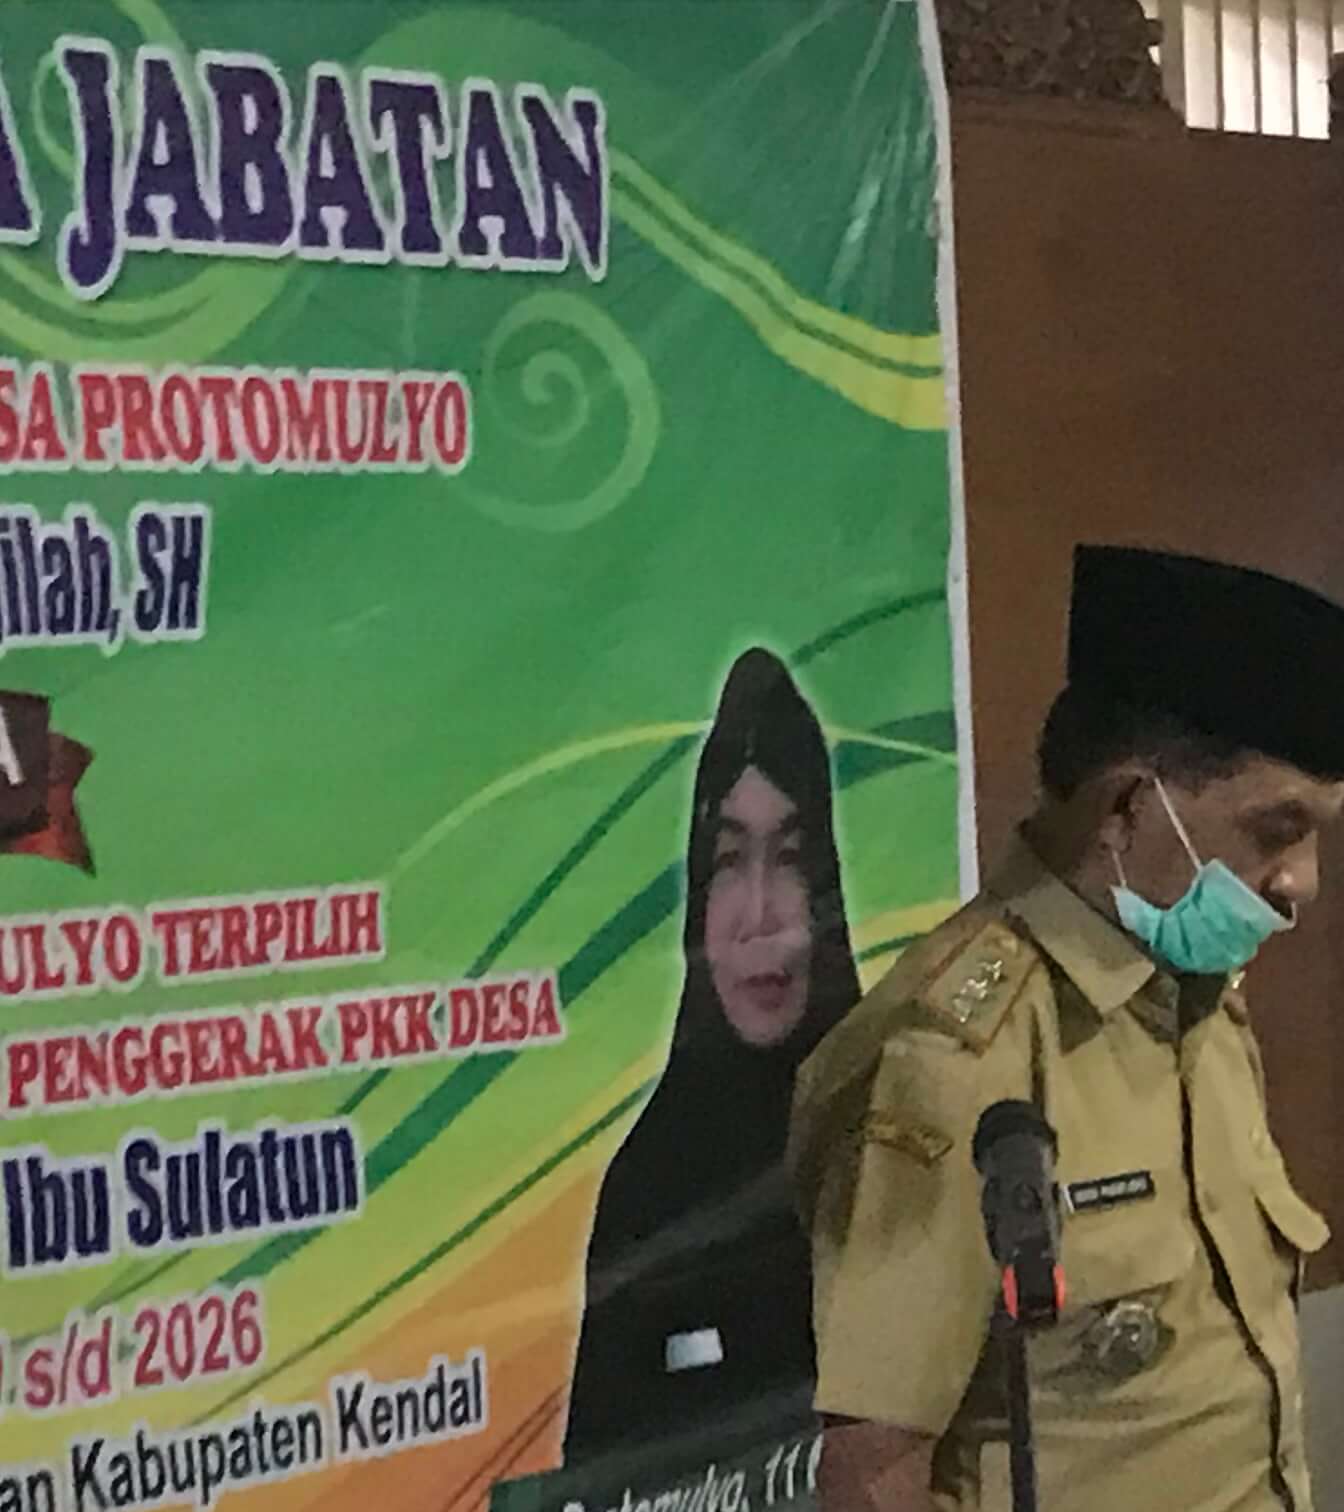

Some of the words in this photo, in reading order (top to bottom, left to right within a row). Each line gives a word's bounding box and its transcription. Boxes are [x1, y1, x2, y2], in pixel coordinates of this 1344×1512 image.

[62, 47, 603, 287] JABATAN
[78, 370, 468, 466] PROTOMULYO
[134, 512, 204, 632] SH
[152, 891, 382, 977] TERPILIH
[8, 1004, 328, 1108] PENGGERAK
[337, 991, 439, 1063] PKK
[448, 977, 562, 1049] DESA
[2, 1155, 112, 1269] Ibu
[124, 1126, 359, 1247] Sulatun
[24, 1315, 112, 1409] s/d
[133, 1289, 263, 1387] 2026
[336, 1356, 483, 1451] Kendal
